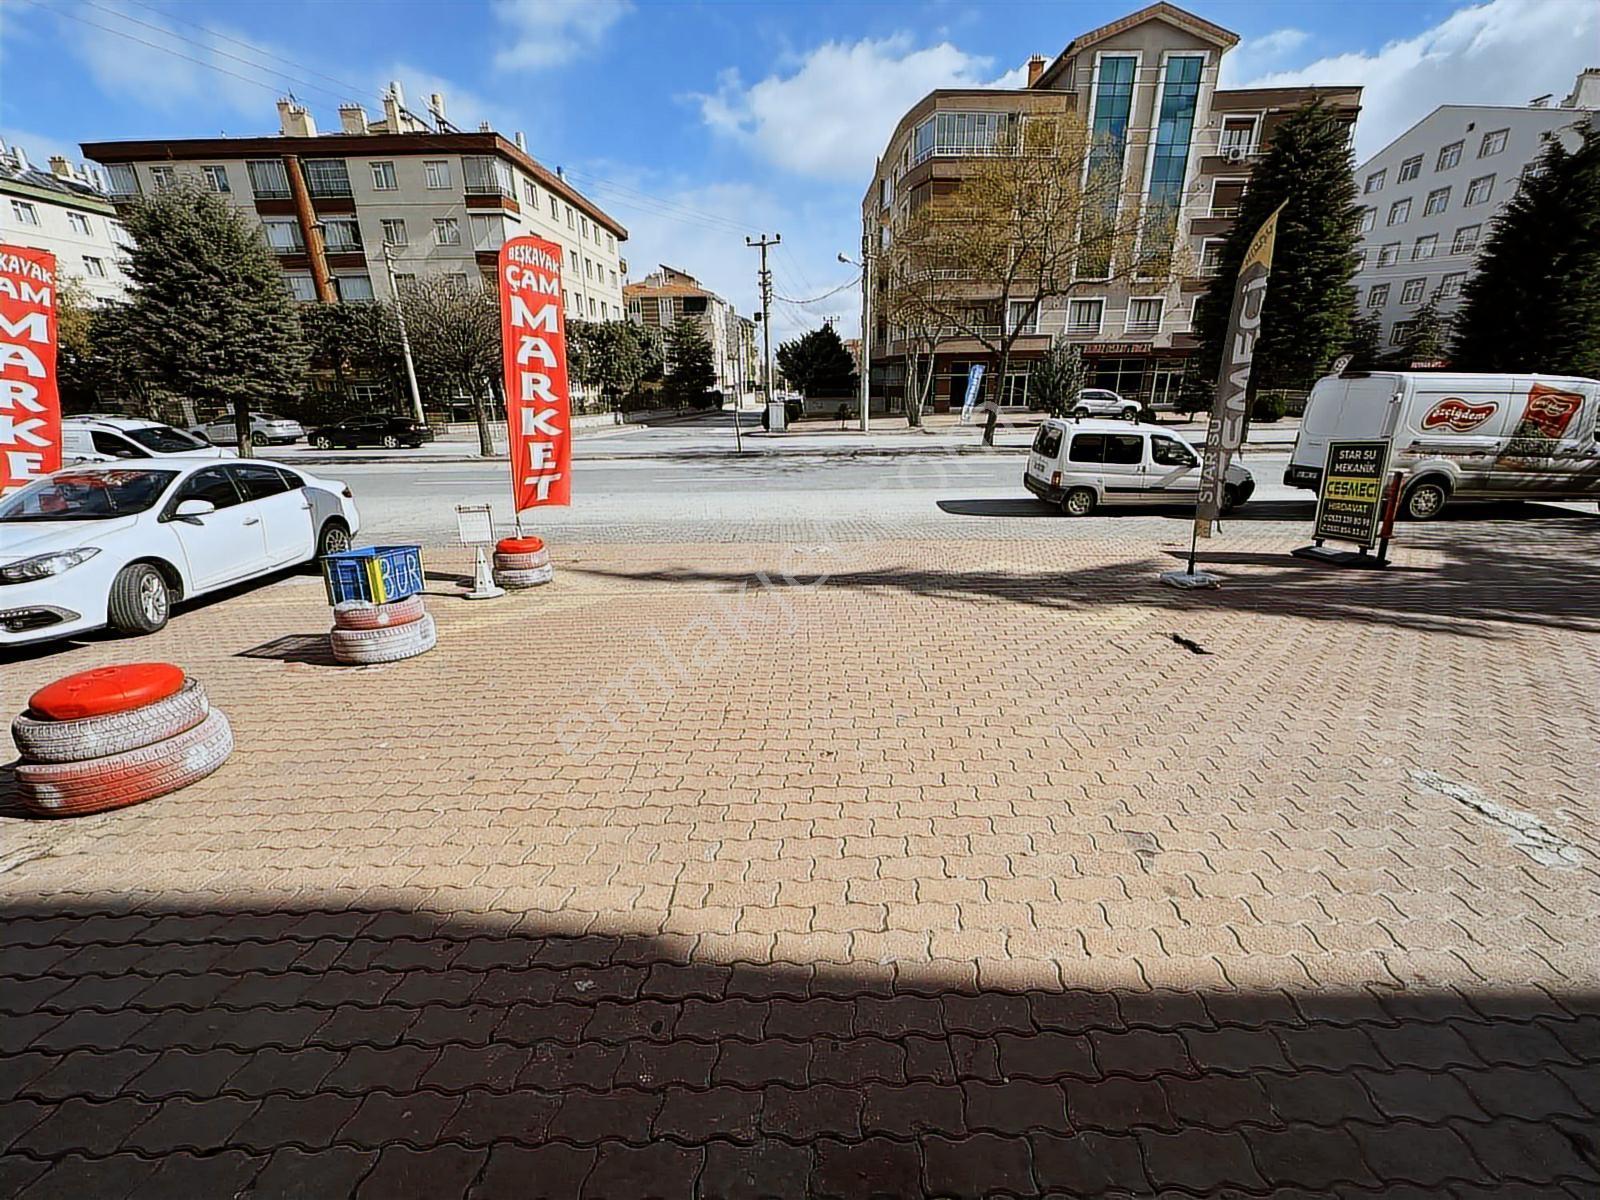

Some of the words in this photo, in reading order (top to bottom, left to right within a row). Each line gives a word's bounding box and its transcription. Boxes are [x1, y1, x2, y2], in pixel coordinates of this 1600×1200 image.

[0, 252, 54, 284] KAVAK
[505, 264, 560, 297] ÇAM
[0, 276, 52, 308] AM
[0, 311, 54, 496] MARKE
[509, 294, 564, 501] MARKET
[1208, 418, 1222, 447] SU
[1338, 450, 1362, 460] STAR
[1363, 449, 1377, 460] SU
[1200, 452, 1218, 503] STAR
